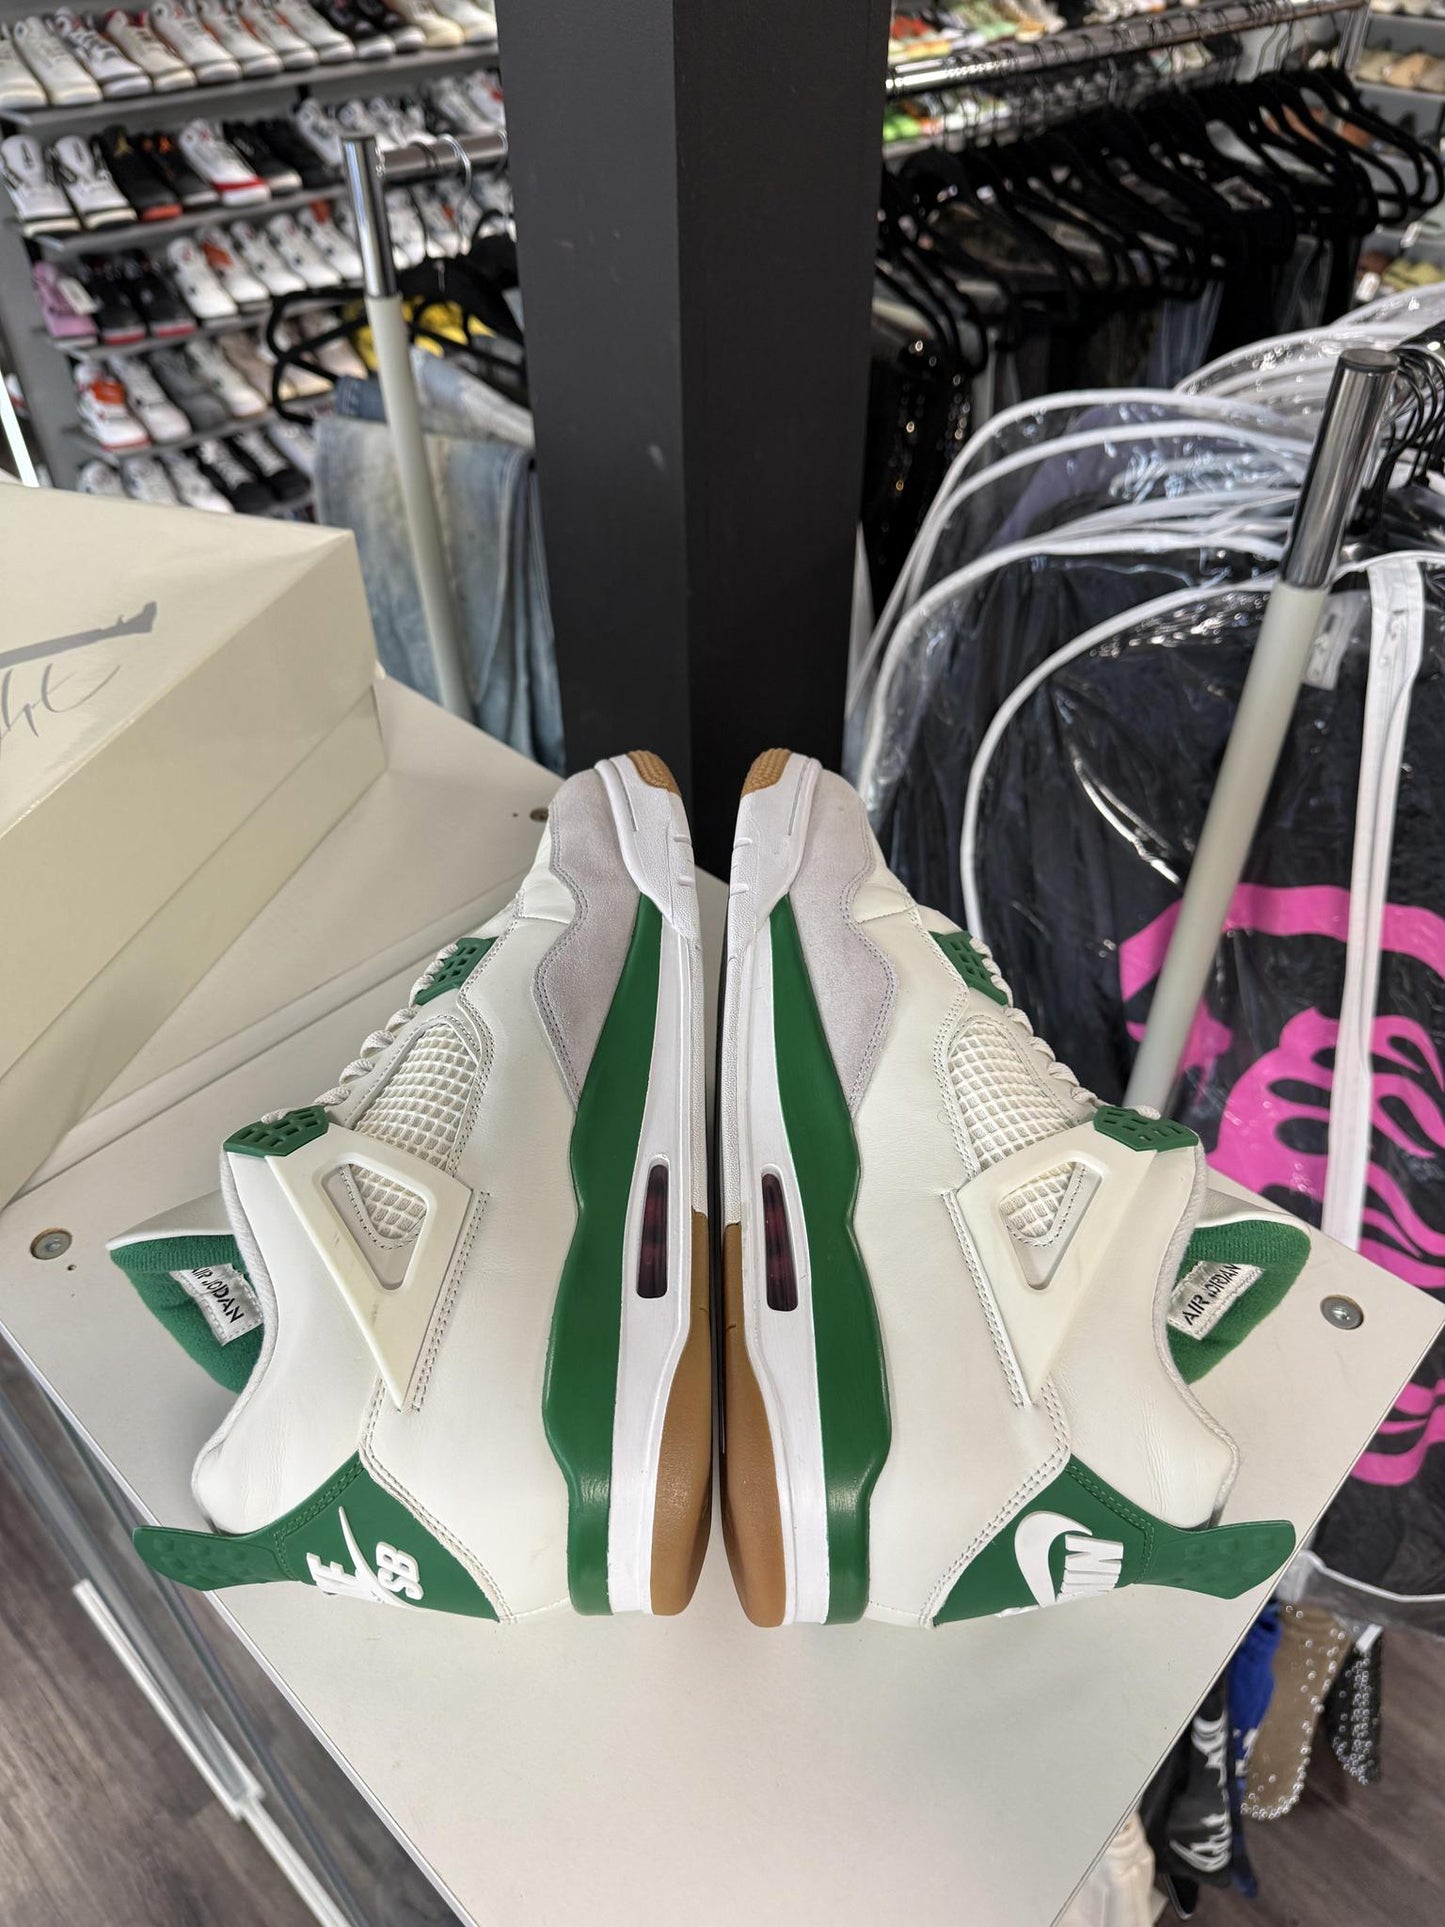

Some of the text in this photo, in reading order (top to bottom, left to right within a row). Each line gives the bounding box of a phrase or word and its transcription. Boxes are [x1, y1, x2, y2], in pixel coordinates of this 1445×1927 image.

[202, 1279, 244, 1323] JODAN
[1182, 1294, 1210, 1326] AIR
[375, 1541, 424, 1600] SB
